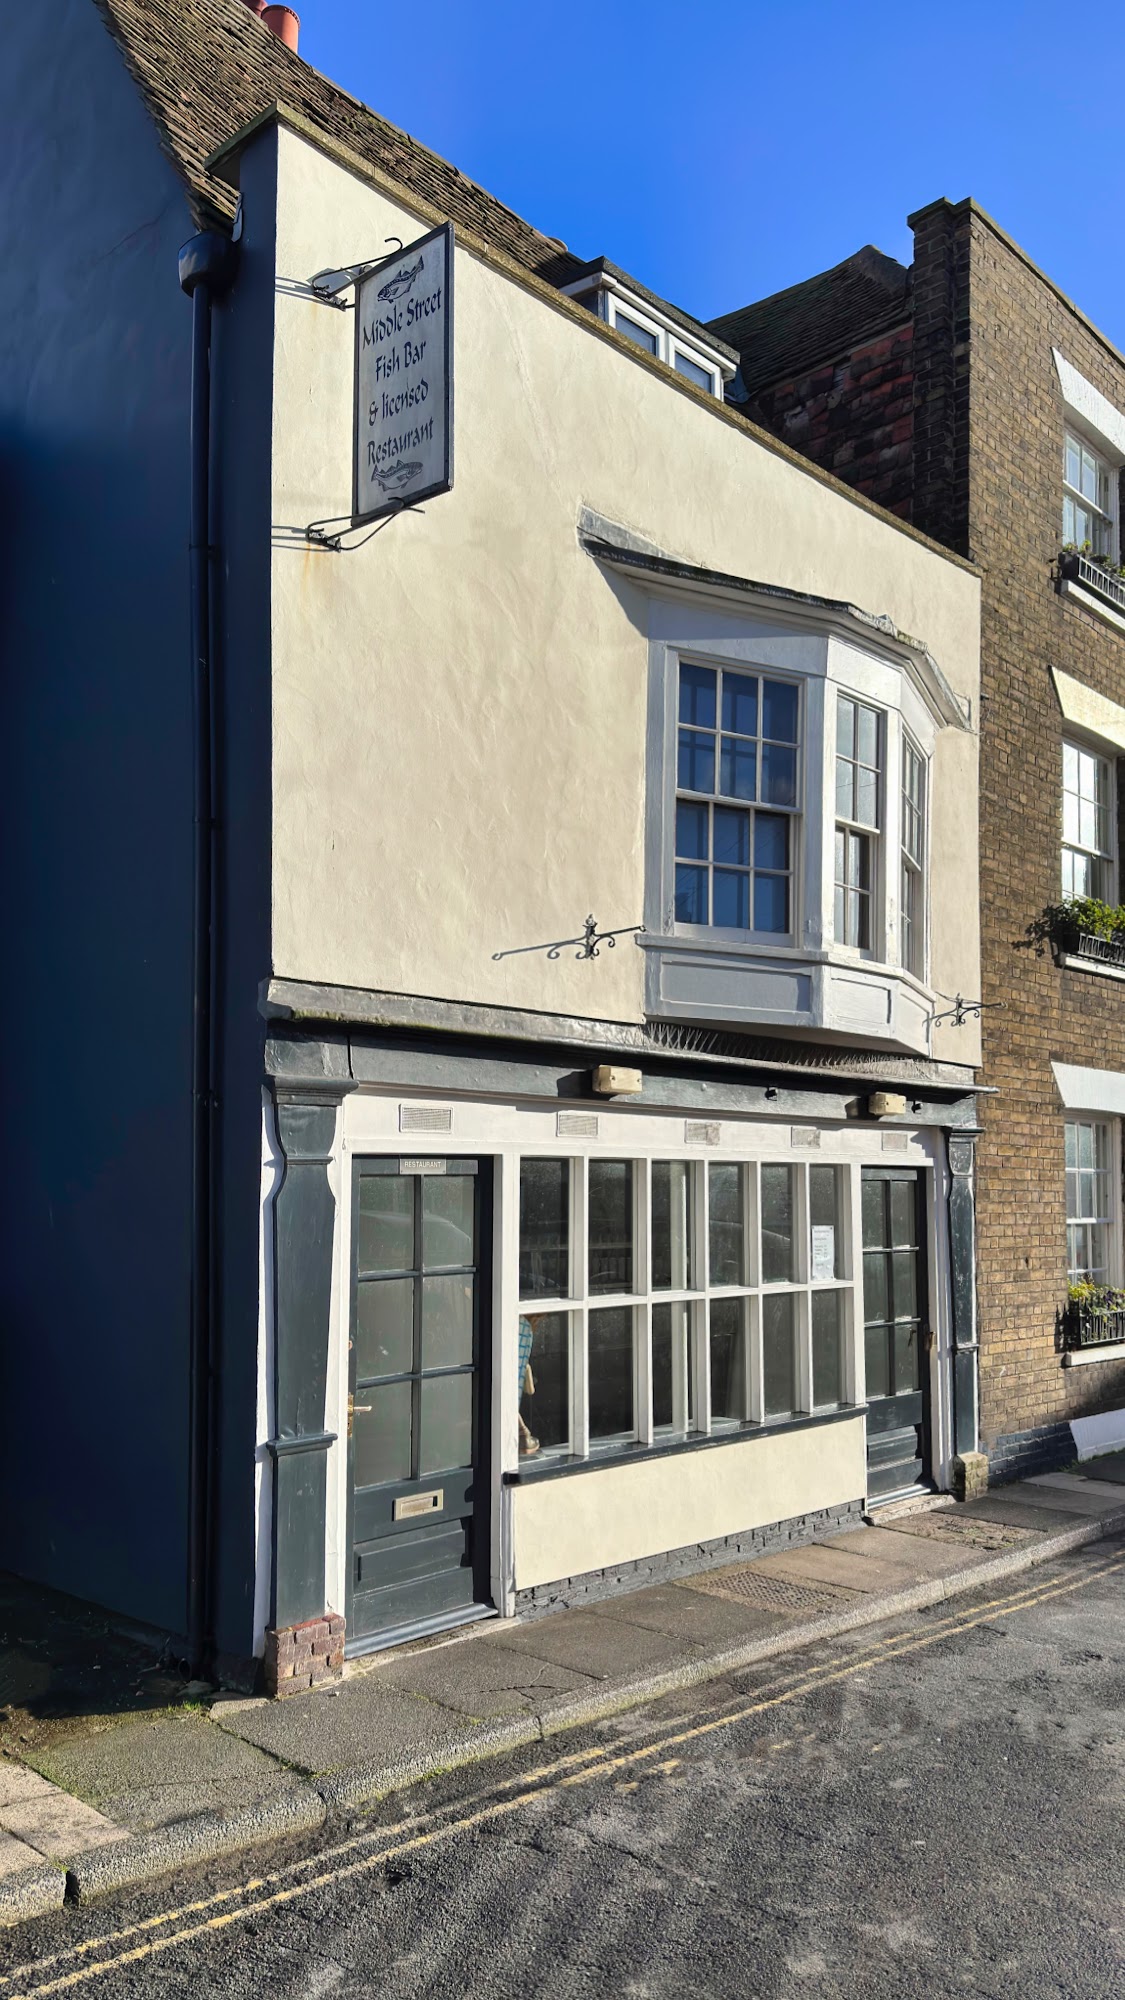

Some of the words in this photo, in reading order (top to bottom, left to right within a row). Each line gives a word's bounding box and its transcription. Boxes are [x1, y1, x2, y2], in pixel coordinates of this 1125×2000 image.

[362, 304, 403, 350] Middle
[406, 287, 442, 327] Street
[375, 346, 400, 382] Fish
[404, 340, 427, 368] Bar
[368, 400, 379, 427] &
[382, 377, 429, 419] licensed
[366, 416, 434, 466] Restaurant
